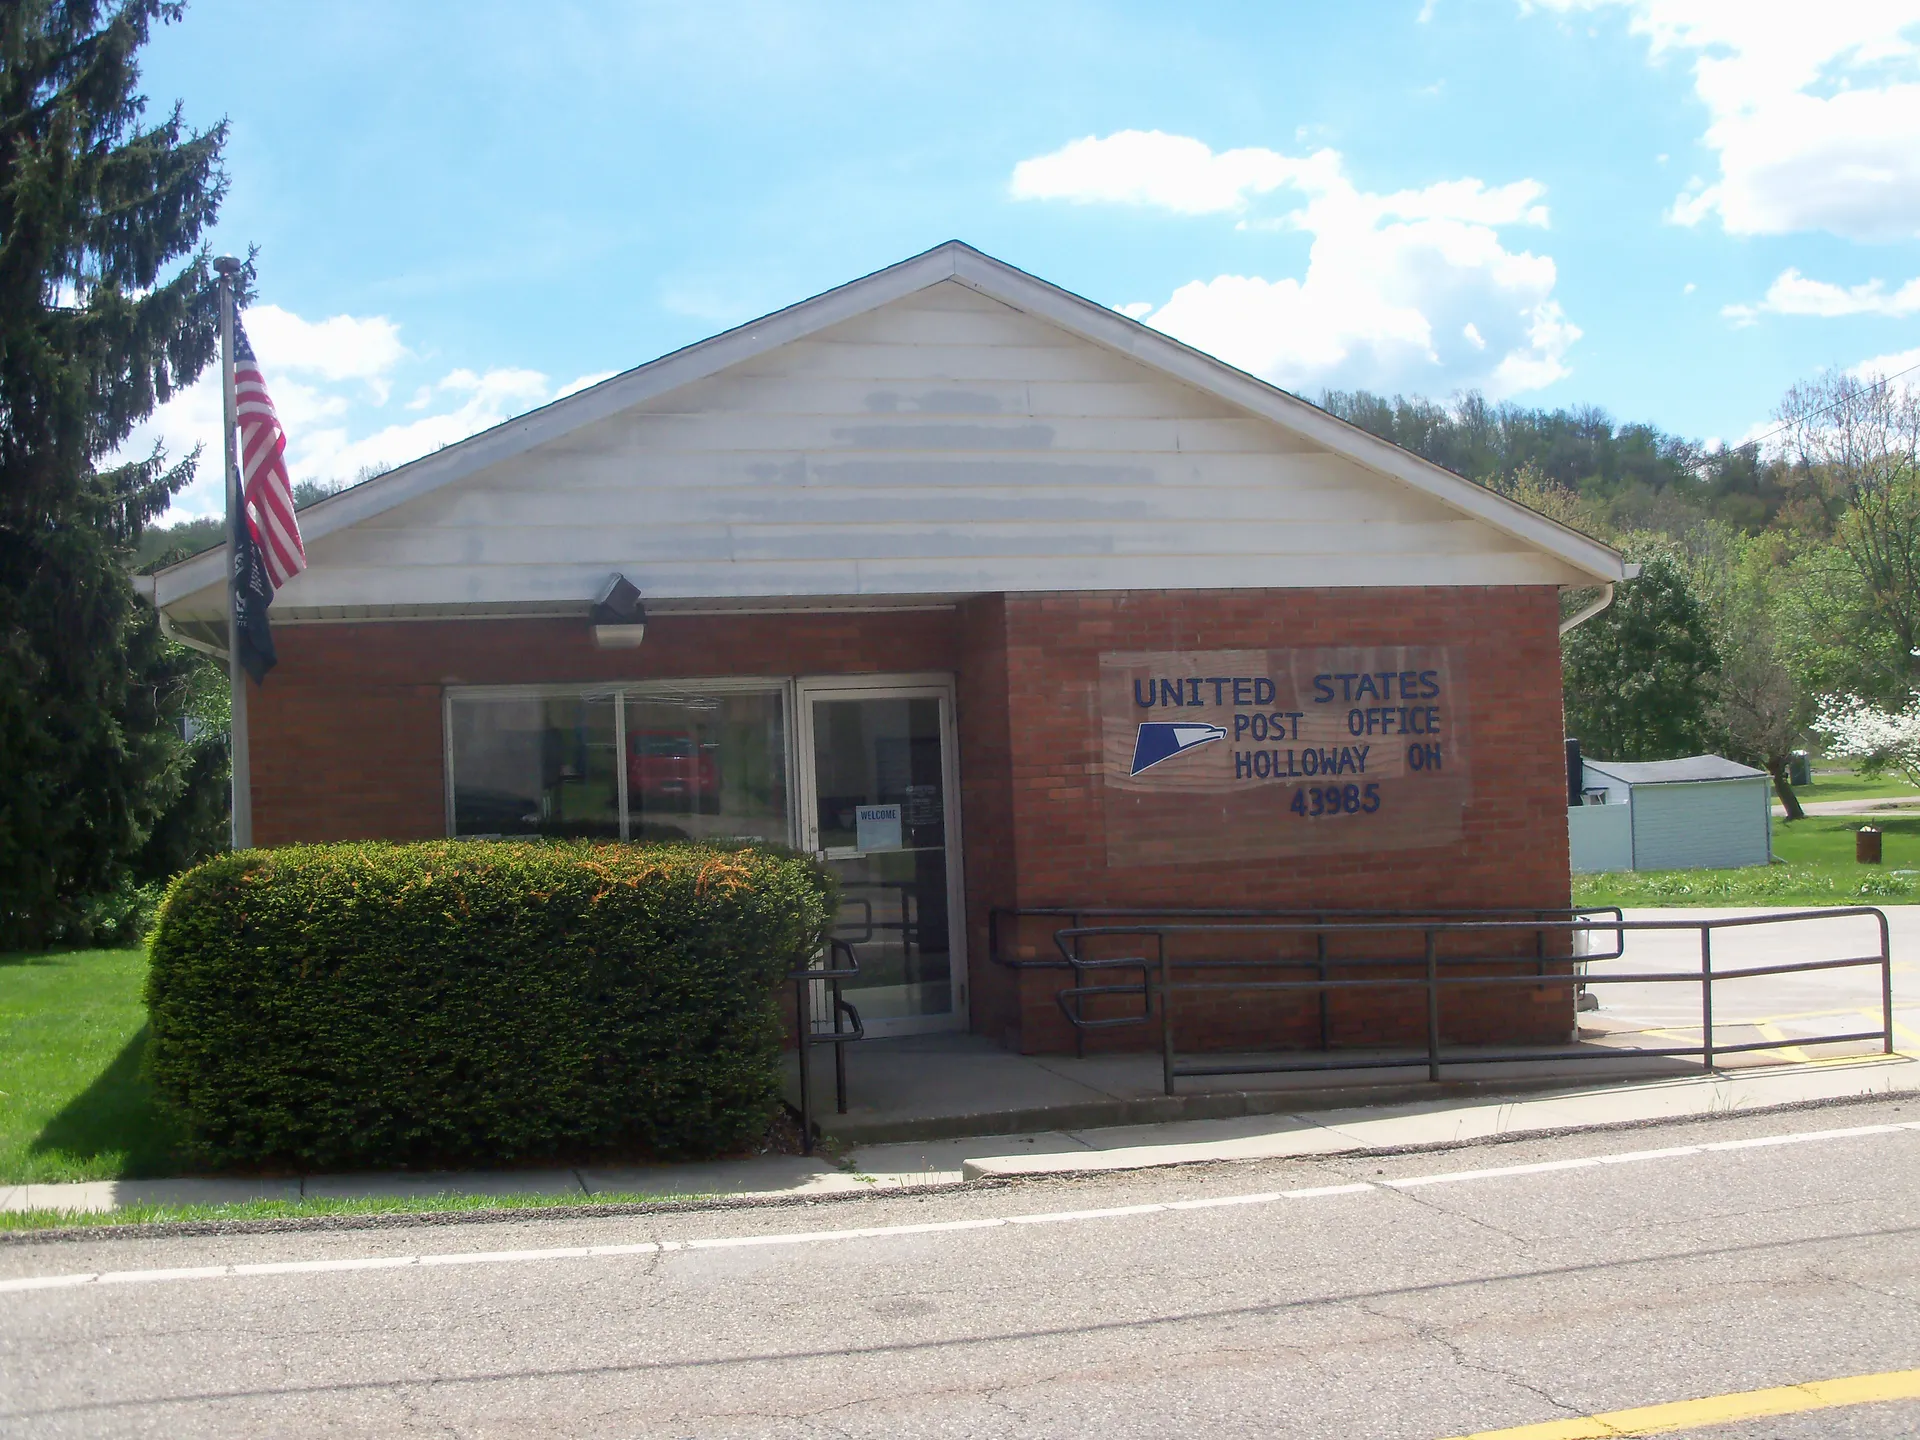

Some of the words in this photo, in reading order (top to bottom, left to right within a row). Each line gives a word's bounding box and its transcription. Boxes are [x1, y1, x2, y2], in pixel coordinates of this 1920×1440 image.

[1135, 677, 1276, 707] UNITED
[1313, 671, 1440, 703] STATES
[1234, 712, 1304, 742] POST
[1348, 706, 1440, 736] OFFICE
[1235, 746, 1370, 779] HOLLOWAY
[1408, 744, 1442, 770] OH
[860, 809, 897, 820] WELCOME
[1290, 783, 1381, 817] 43985
